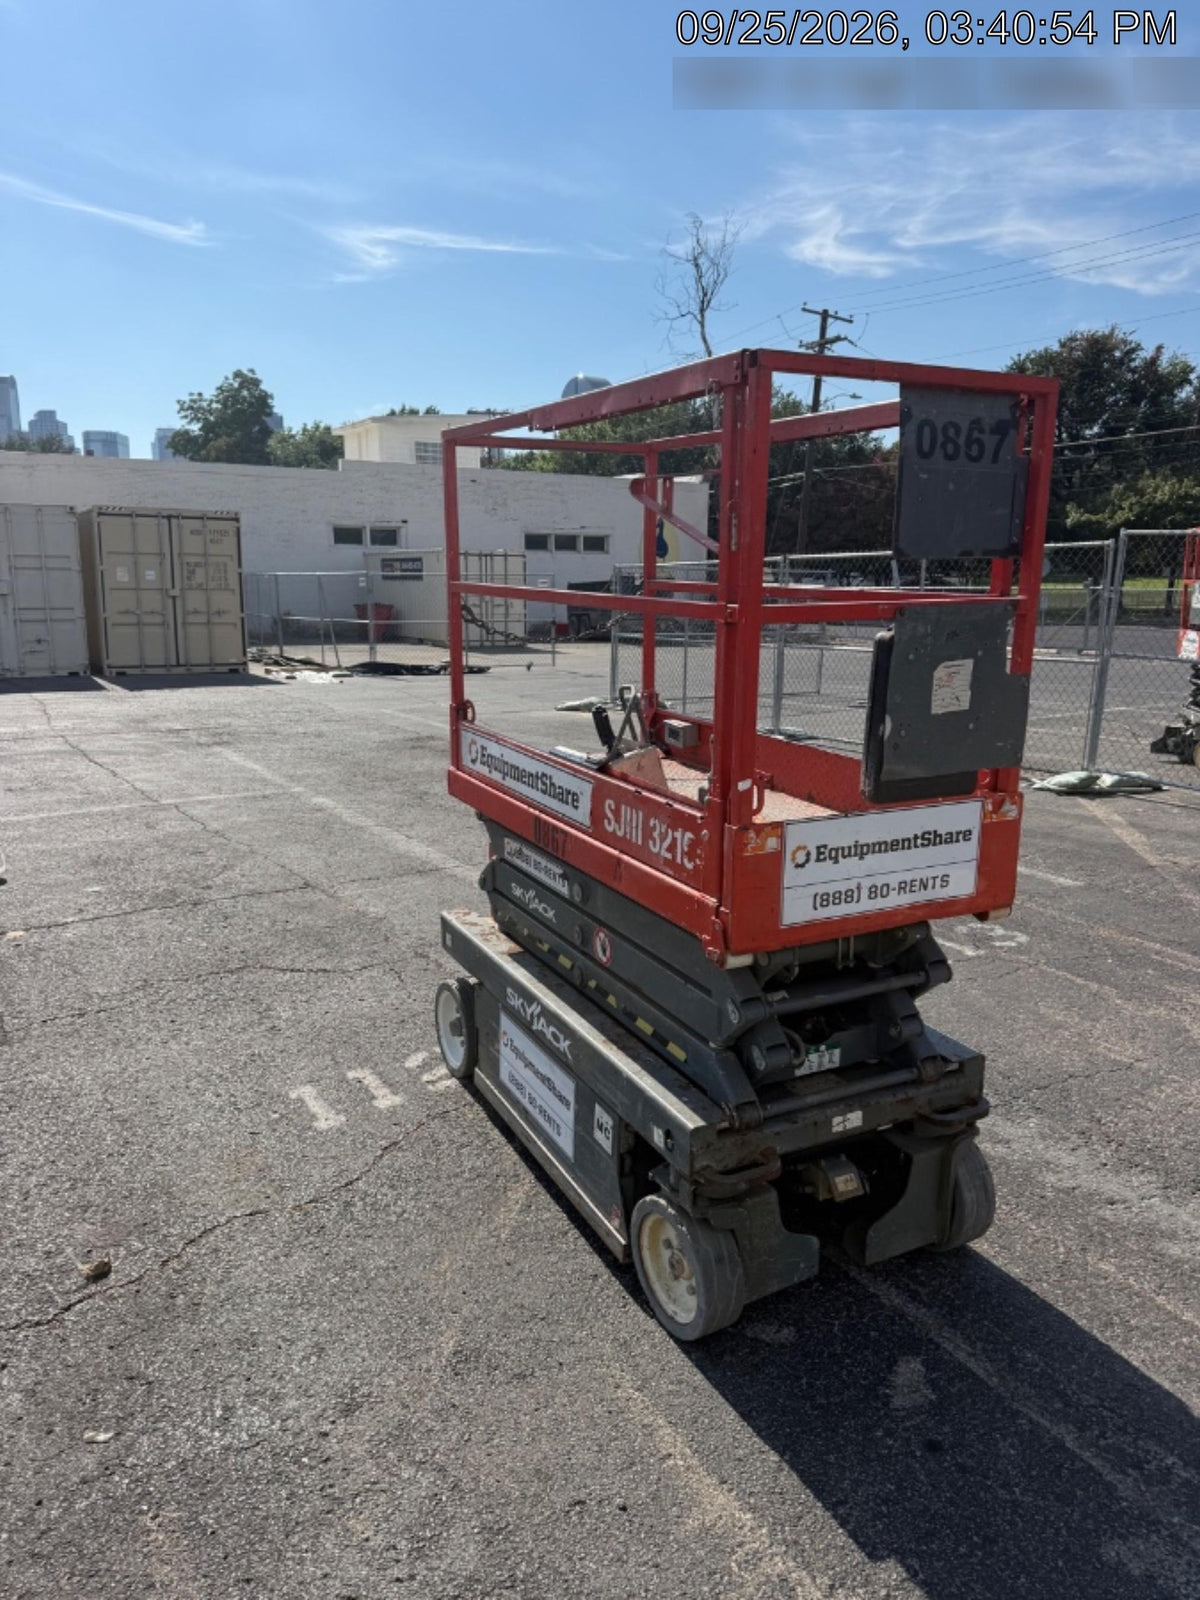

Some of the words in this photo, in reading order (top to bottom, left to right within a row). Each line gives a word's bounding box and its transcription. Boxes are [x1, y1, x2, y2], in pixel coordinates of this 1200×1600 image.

[916, 418, 1011, 464] 0867
[480, 744, 580, 810] EquipmentShare
[814, 828, 973, 864] EquipmentShare
[511, 882, 556, 923] SKYJACK
[812, 882, 862, 911] (888)
[868, 874, 950, 900] 80-RENTS
[506, 986, 573, 1062] SKYJACK
